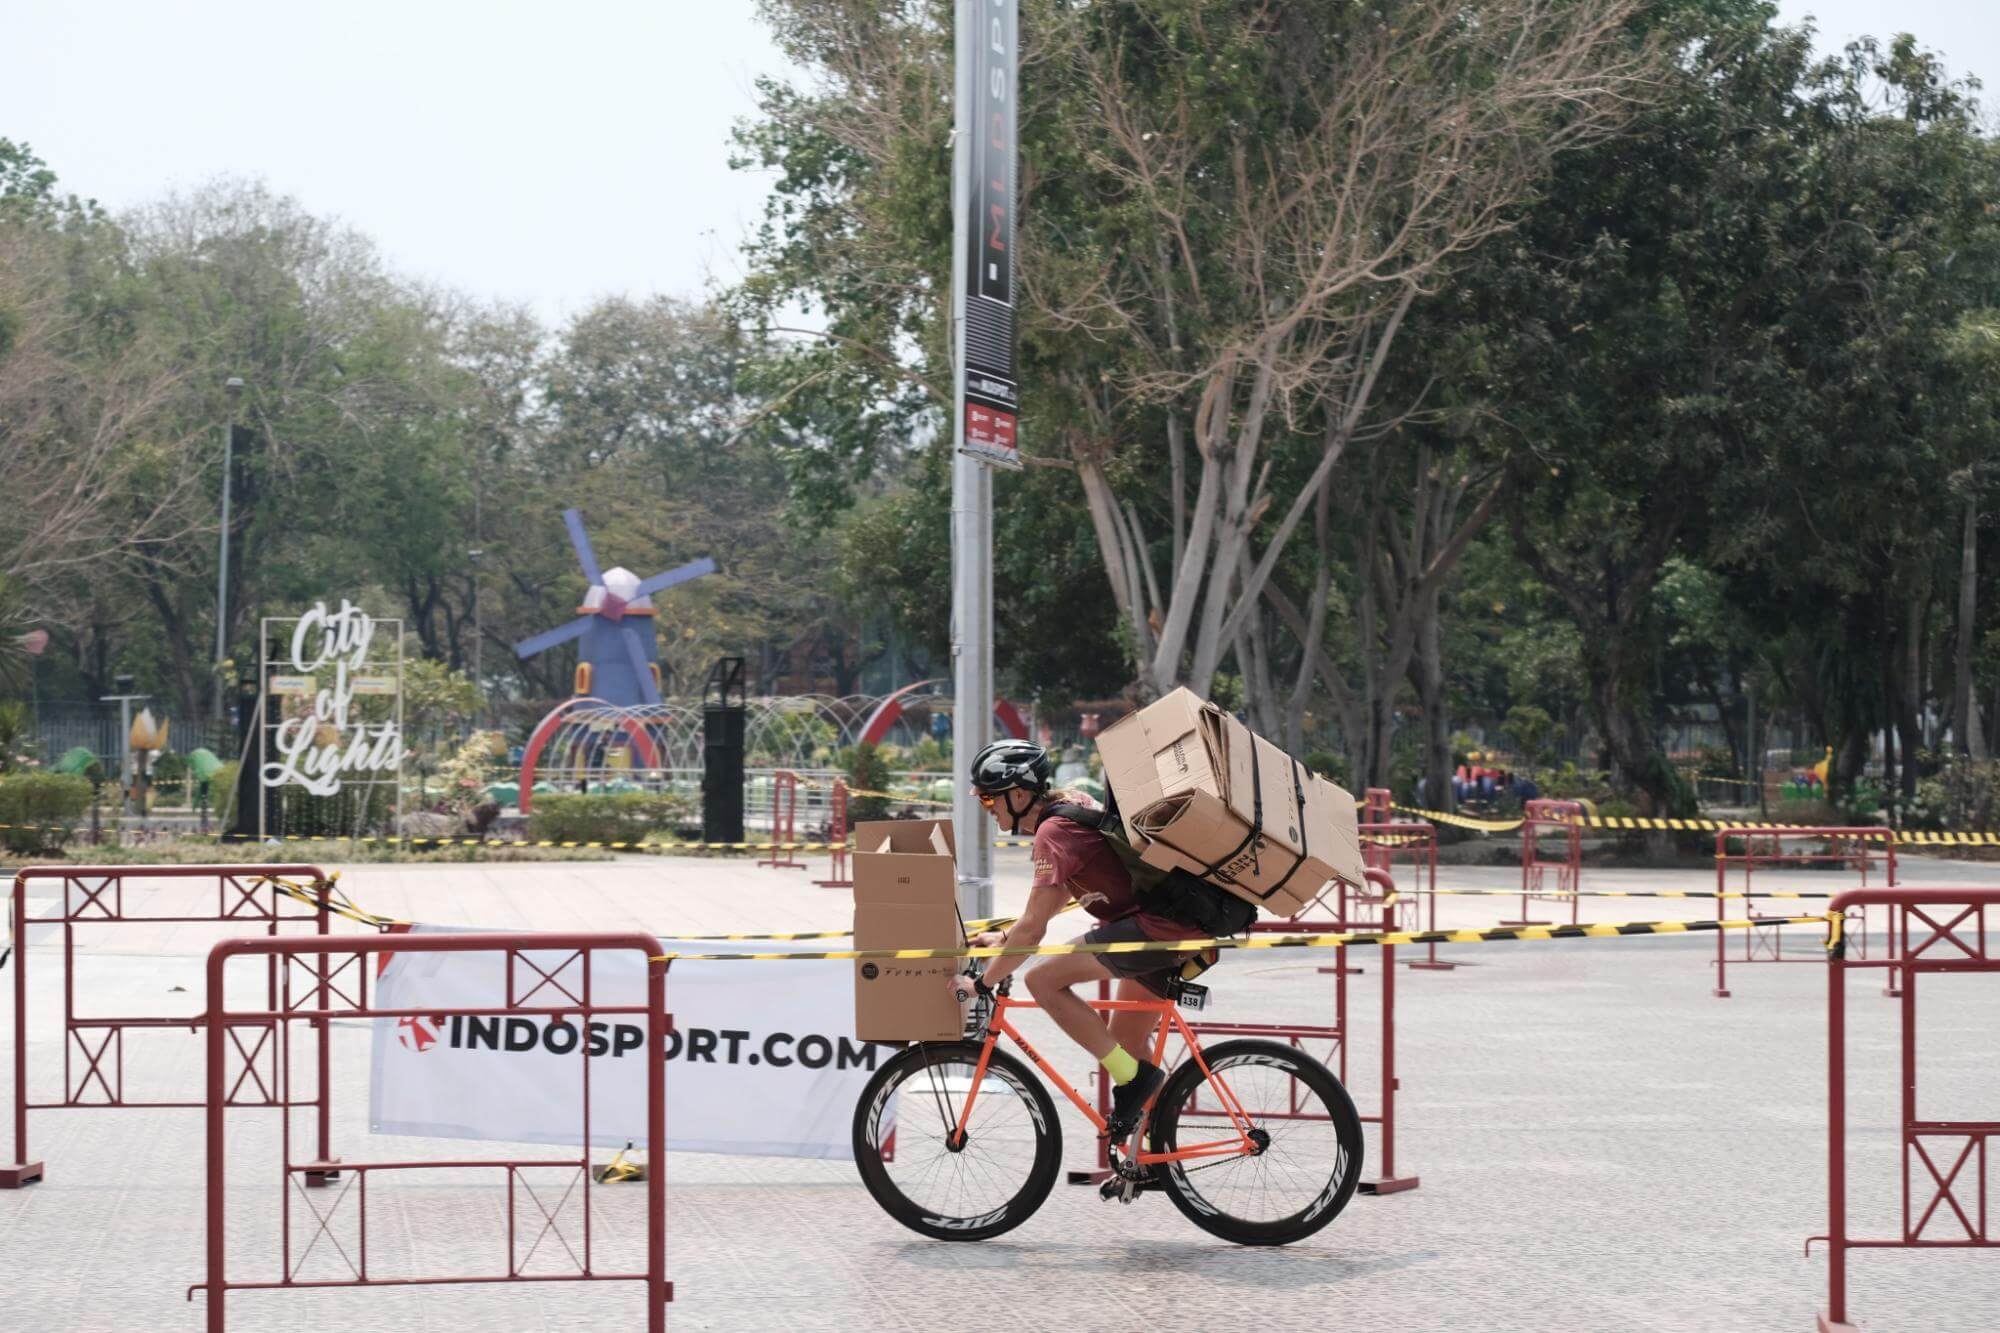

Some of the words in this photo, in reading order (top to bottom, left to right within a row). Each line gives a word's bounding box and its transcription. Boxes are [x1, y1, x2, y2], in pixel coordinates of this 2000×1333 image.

[990, 0, 1007, 251] MLDSP
[291, 598, 375, 672] City
[315, 658, 353, 731] of
[260, 717, 411, 796] Lights
[988, 1065, 1047, 1136] ZIPP
[1211, 1054, 1300, 1073] ZIPP
[865, 1069, 904, 1151] ZIPP
[921, 1205, 1009, 1230] ZIPP
[1303, 1144, 1349, 1223] ZIPP
